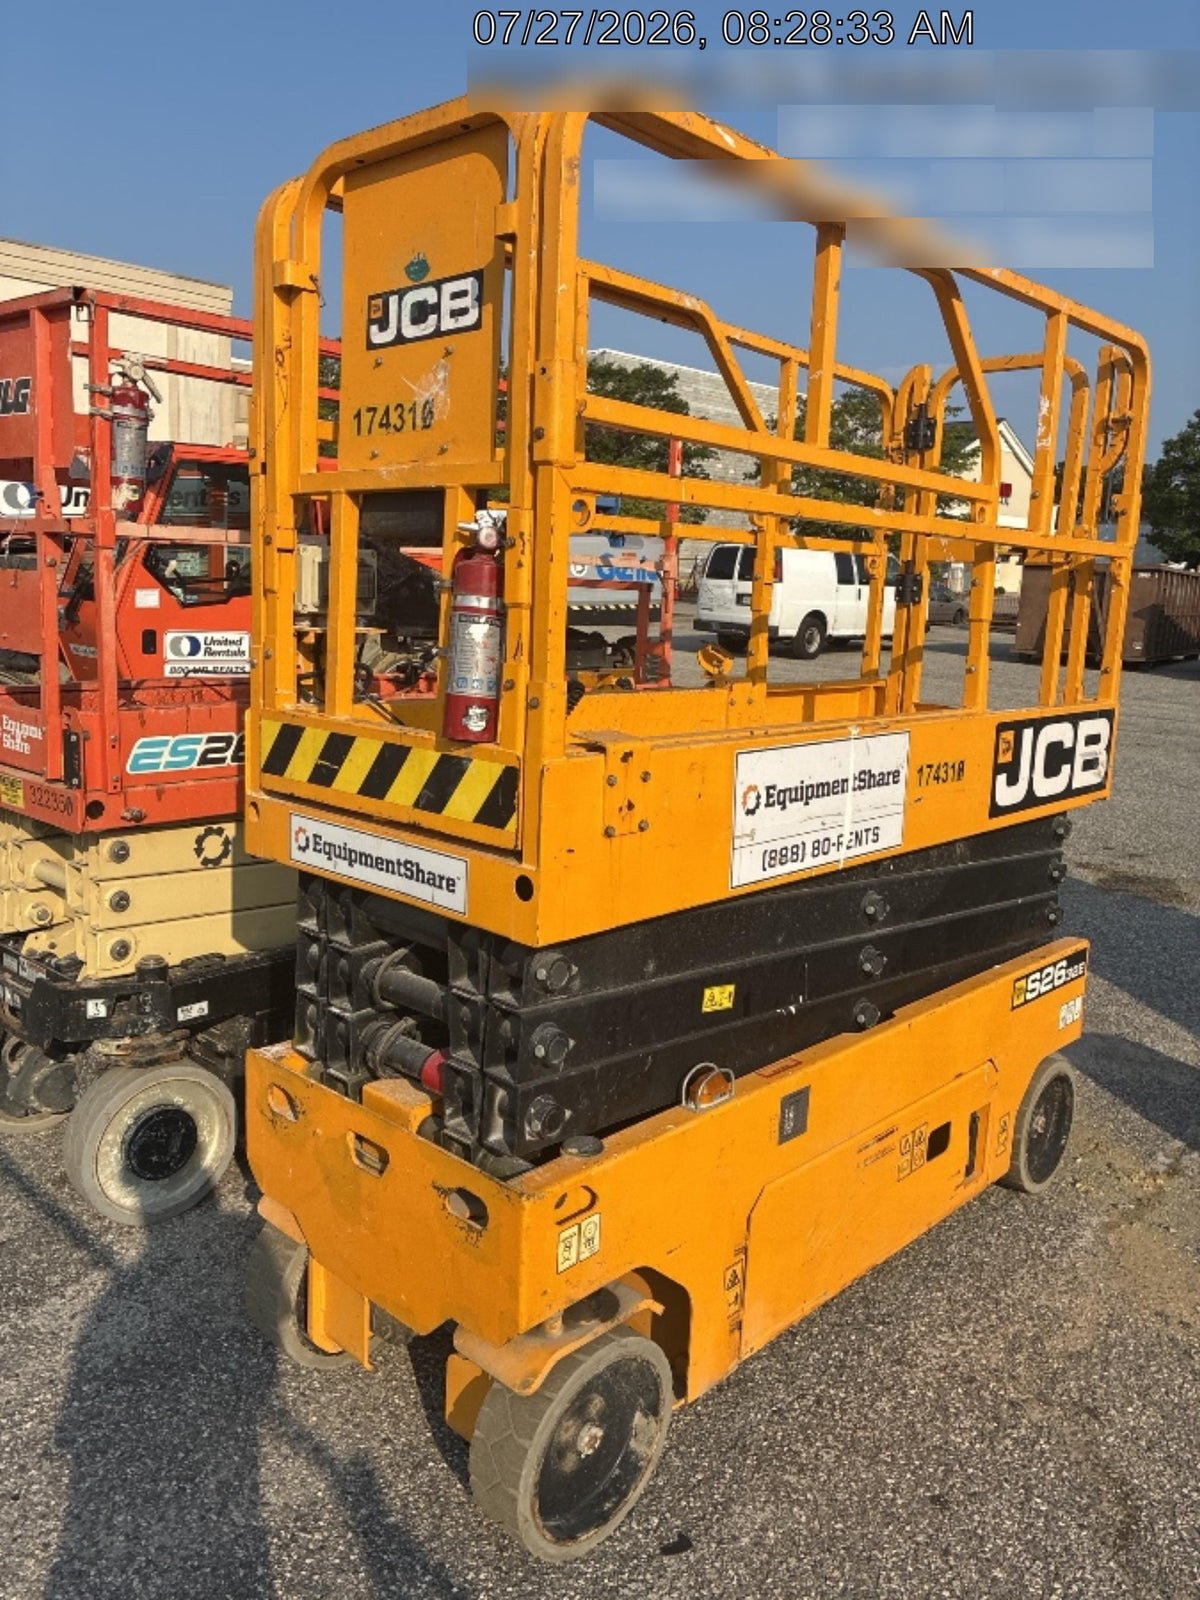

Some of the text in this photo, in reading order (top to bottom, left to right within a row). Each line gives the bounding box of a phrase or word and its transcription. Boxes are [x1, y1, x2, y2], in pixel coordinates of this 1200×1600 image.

[369, 276, 480, 345] JCB
[203, 636, 243, 647] United
[203, 647, 246, 657] Rentals
[2, 733, 31, 755] Share
[995, 717, 1111, 807] JCB
[764, 768, 901, 811] EquipmentShare
[312, 833, 457, 894] EquipmentShare
[761, 840, 806, 872] (888)
